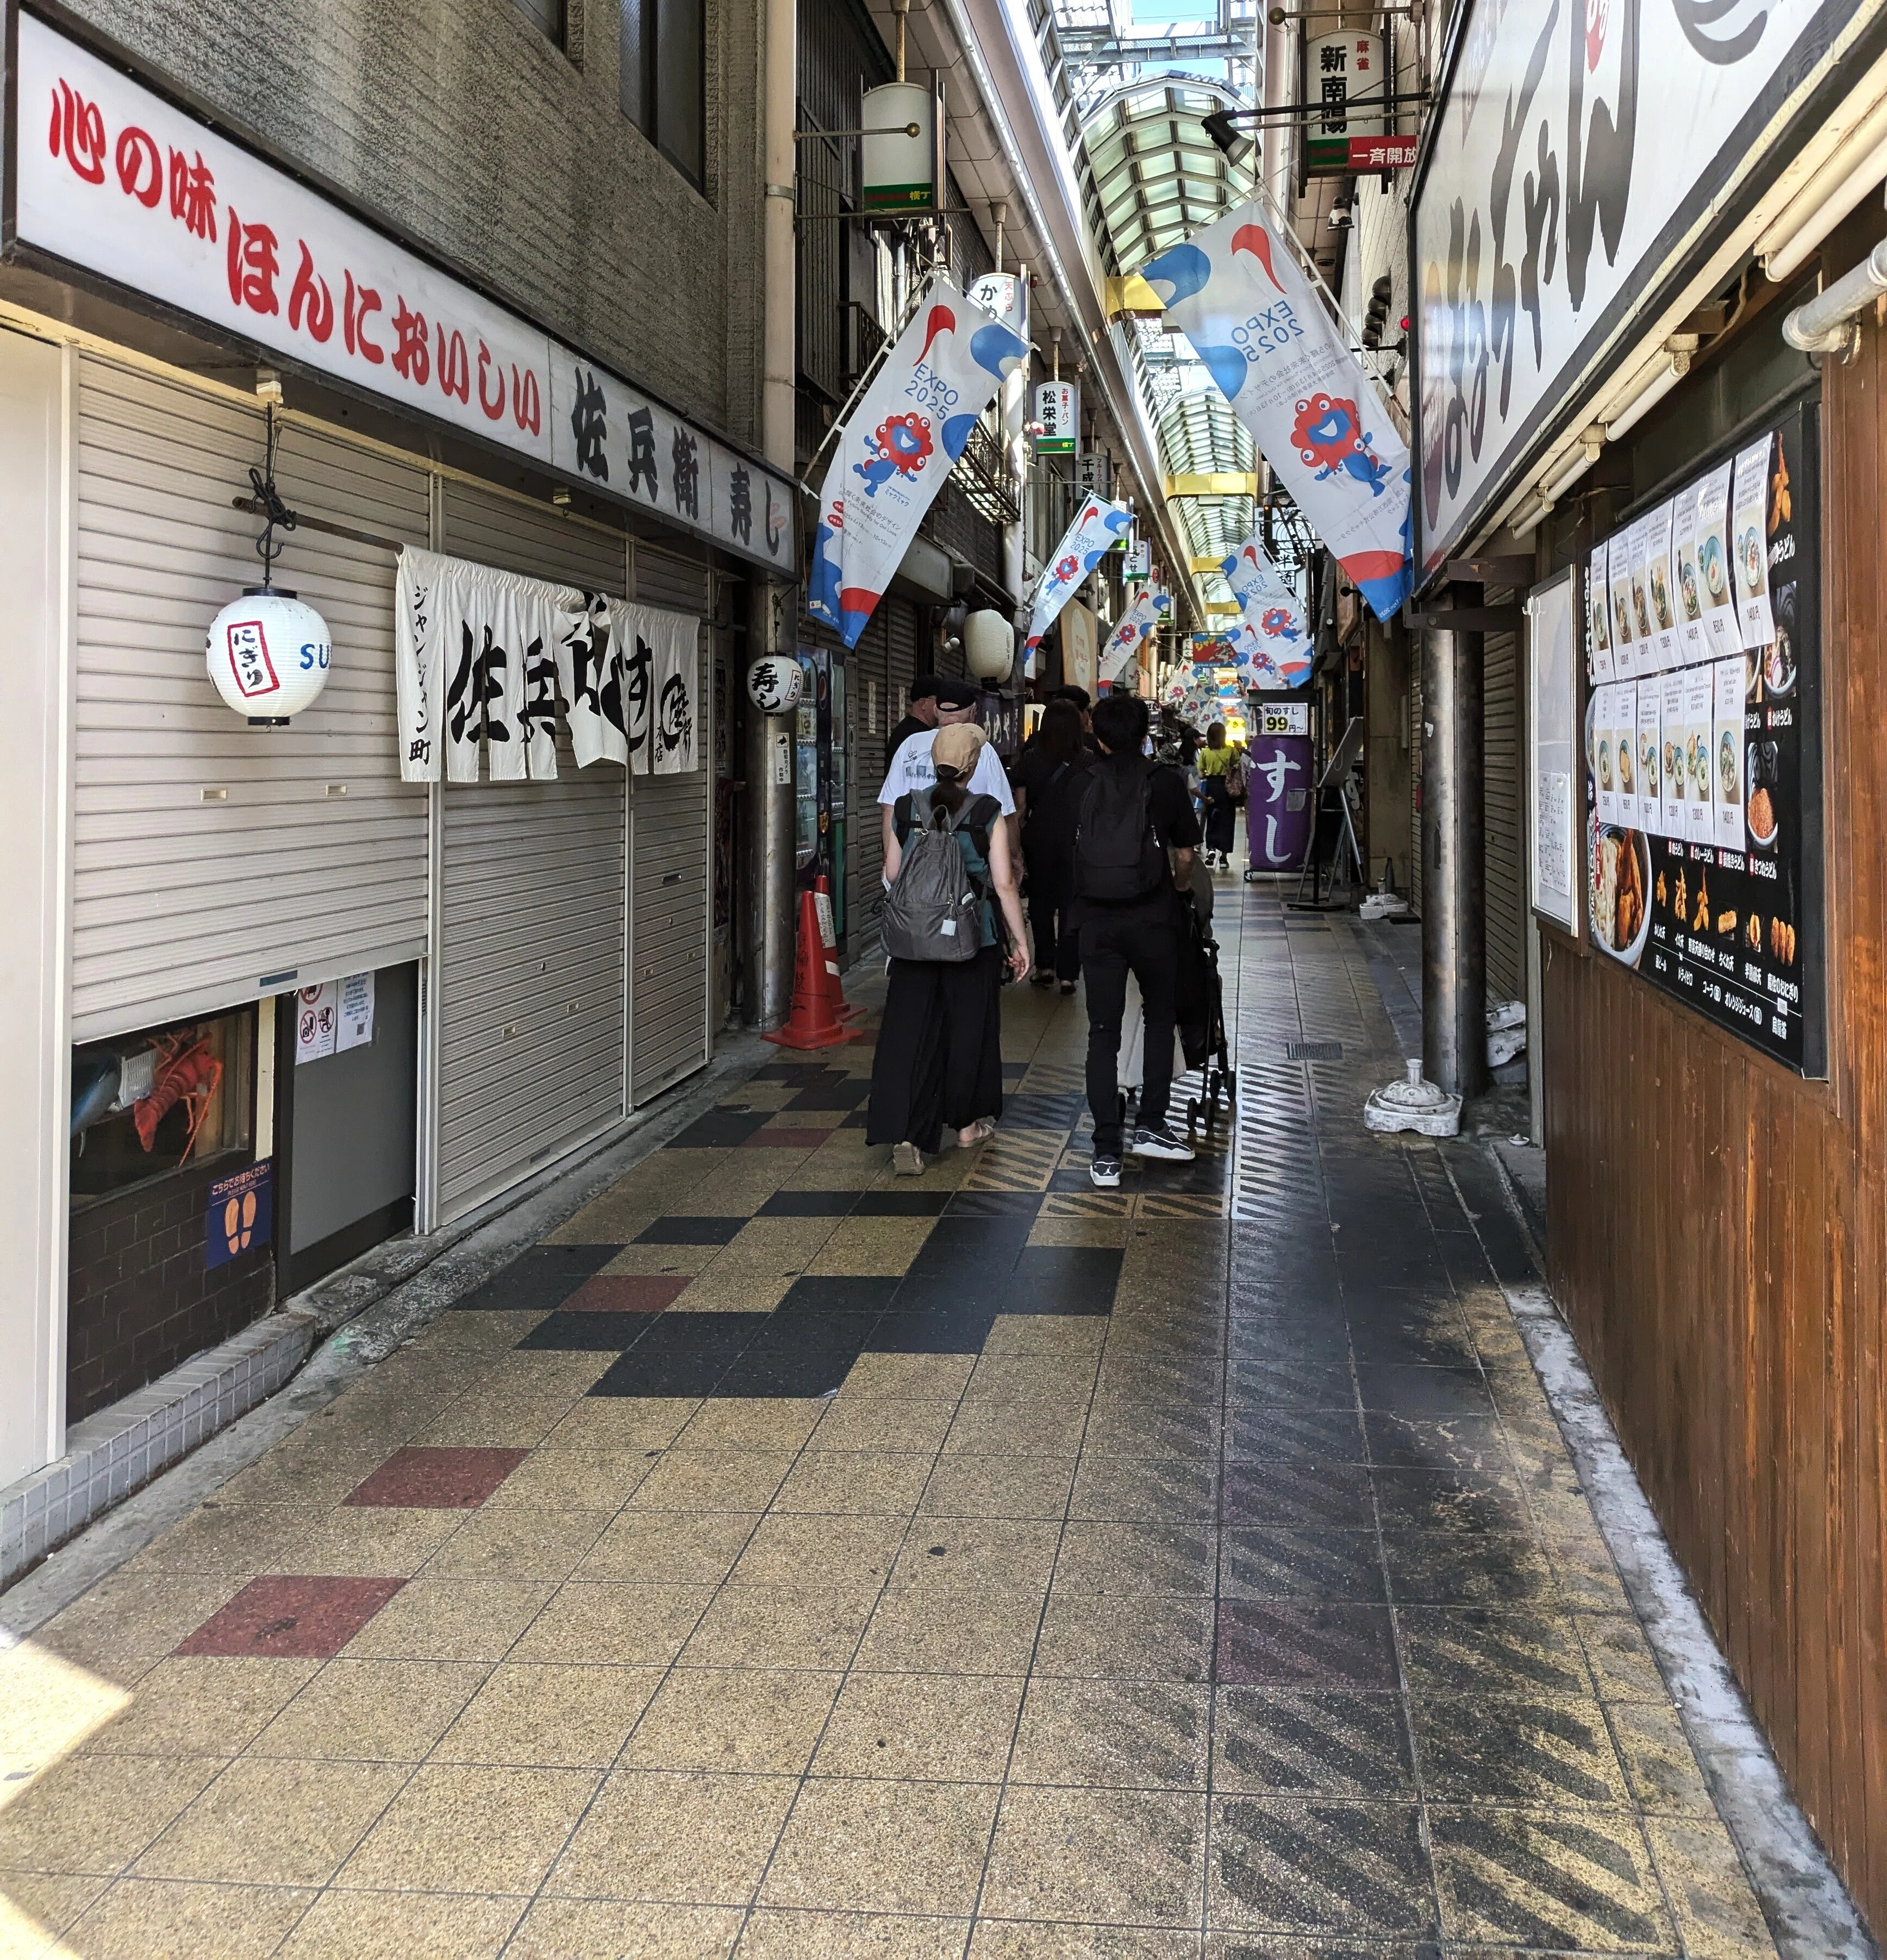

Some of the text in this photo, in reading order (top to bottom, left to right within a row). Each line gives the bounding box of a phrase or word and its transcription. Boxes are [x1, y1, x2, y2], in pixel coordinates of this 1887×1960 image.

[1357, 40, 1370, 70] 麻雀
[1352, 147, 1417, 165] 一斉開放
[910, 190, 932, 201] 横丁
[49, 77, 540, 437] 心の味 ほんにおいしい
[1005, 281, 1013, 312] 天ぷら
[914, 363, 959, 406] EXPO
[904, 379, 950, 421] 2025
[1042, 390, 1057, 437] 松栄堂
[730, 462, 779, 556] 寿し
[883, 488, 910, 507] ミャクミャク
[1070, 541, 1090, 555] 2025
[1075, 534, 1095, 548] EXPO
[1133, 609, 1147, 621] EXPO
[1746, 605, 1759, 621] 1400円
[234, 629, 263, 688] にぎり
[408, 585, 431, 767] ジャンジャン町
[752, 662, 780, 710] 寿し
[1265, 706, 1299, 716] 旬のすし
[1772, 707, 1792, 728] かけうどん
[1257, 749, 1301, 863] すし
[1695, 844, 1714, 864] カレーうどん
[1754, 859, 1777, 880] きつねうどん
[1719, 951, 1734, 972] ちくわ天
[212, 1163, 270, 1195] こちらでお待ちください
